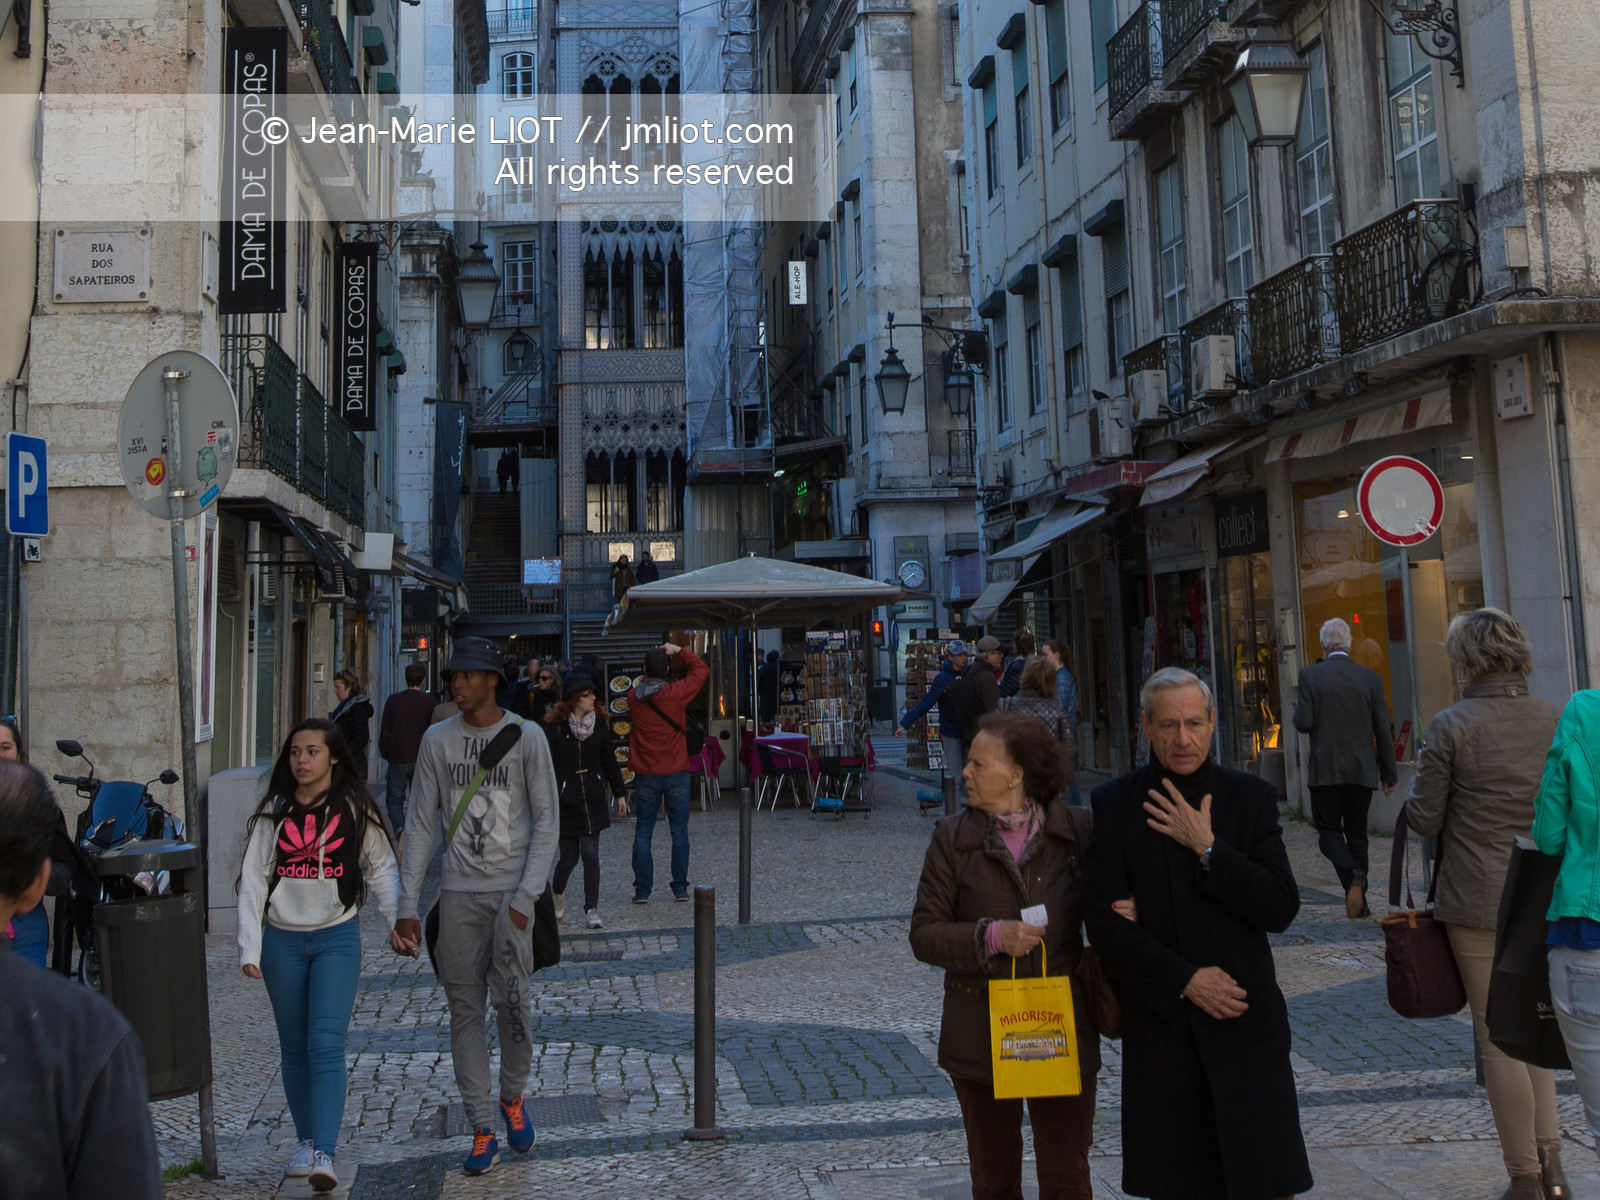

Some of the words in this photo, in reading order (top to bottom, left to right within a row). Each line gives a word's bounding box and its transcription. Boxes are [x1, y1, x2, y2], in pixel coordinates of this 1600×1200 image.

[242, 167, 266, 200] DE
[91, 243, 114, 253] RUA
[241, 212, 266, 281] DAMA
[91, 259, 114, 269] DOS
[69, 275, 135, 286] SAPATEIROS
[793, 265, 801, 300] ALE-HOP
[347, 335, 364, 357] DE
[346, 365, 364, 411] DAMA
[211, 420, 226, 429] CML
[131, 437, 144, 446] XVI
[18, 451, 39, 518] P
[1220, 505, 1256, 550] collect
[277, 862, 344, 878] addiced
[507, 975, 526, 1044] adidas
